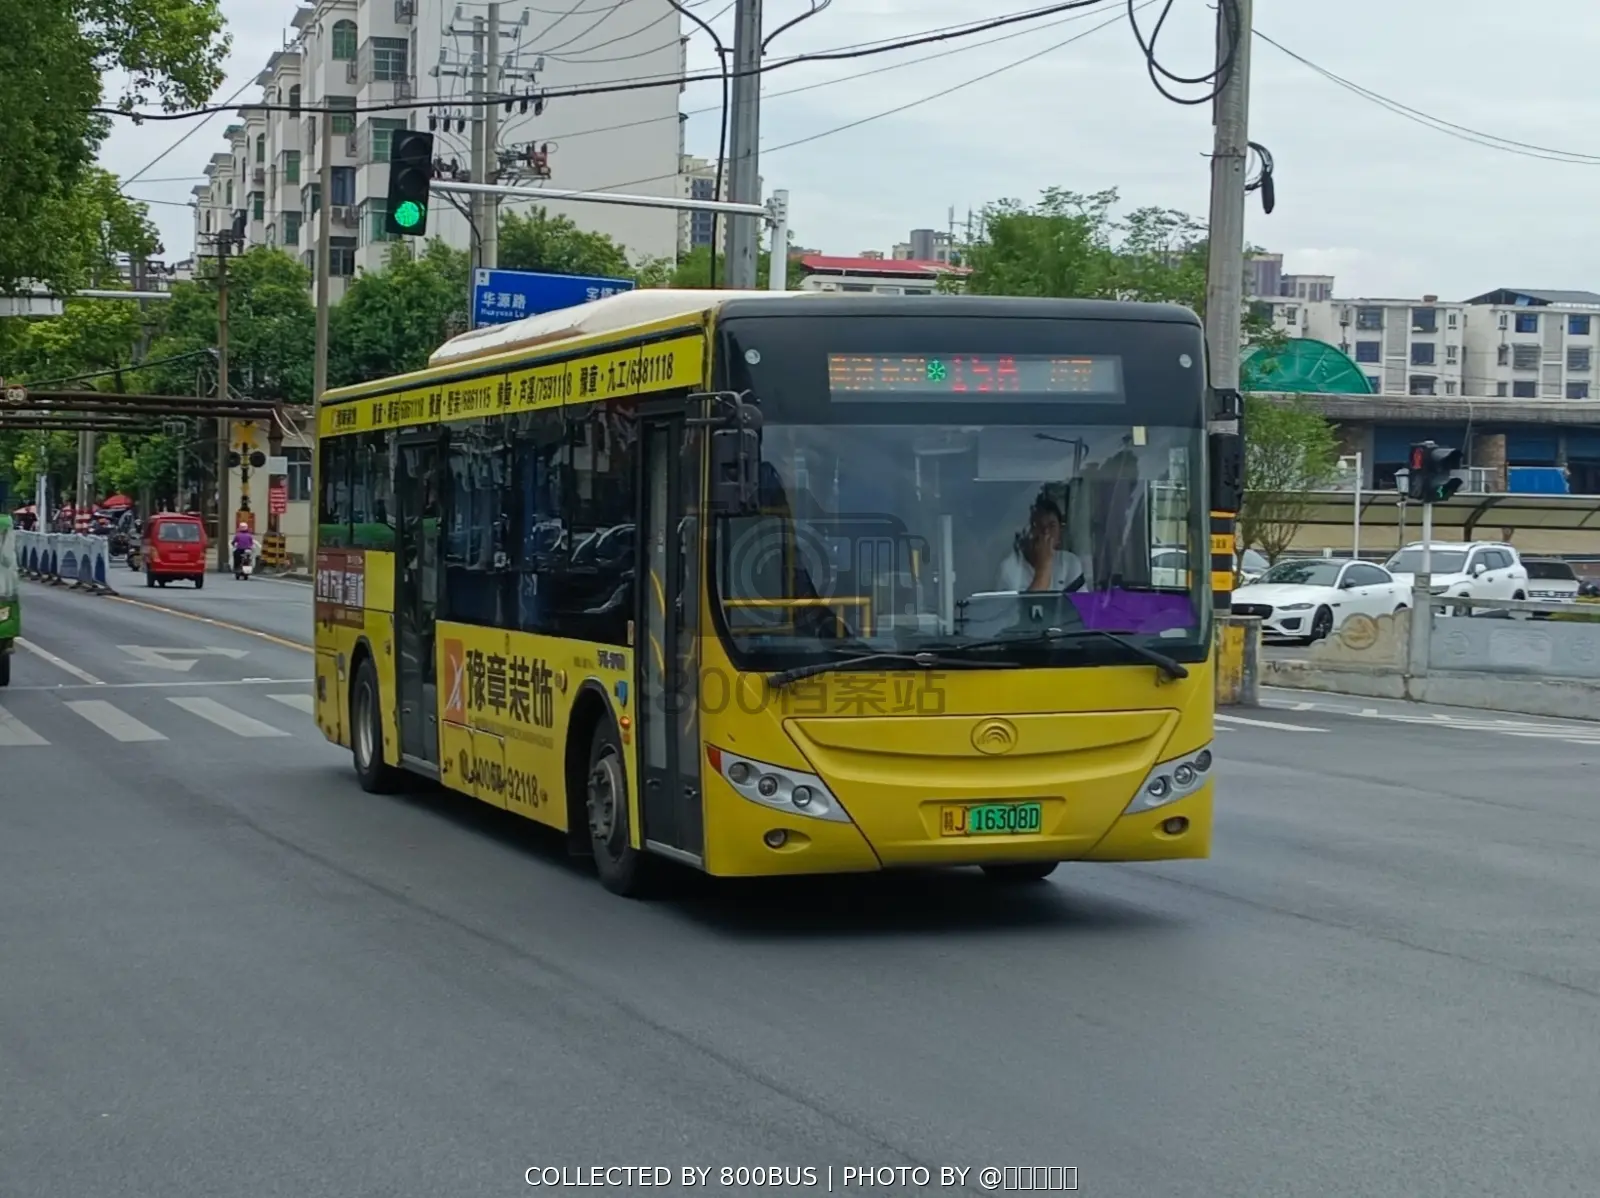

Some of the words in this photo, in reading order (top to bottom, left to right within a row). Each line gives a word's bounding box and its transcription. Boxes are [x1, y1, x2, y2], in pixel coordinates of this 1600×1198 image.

[481, 291, 527, 310] 华源路
[465, 648, 554, 729] 豫章装饰
